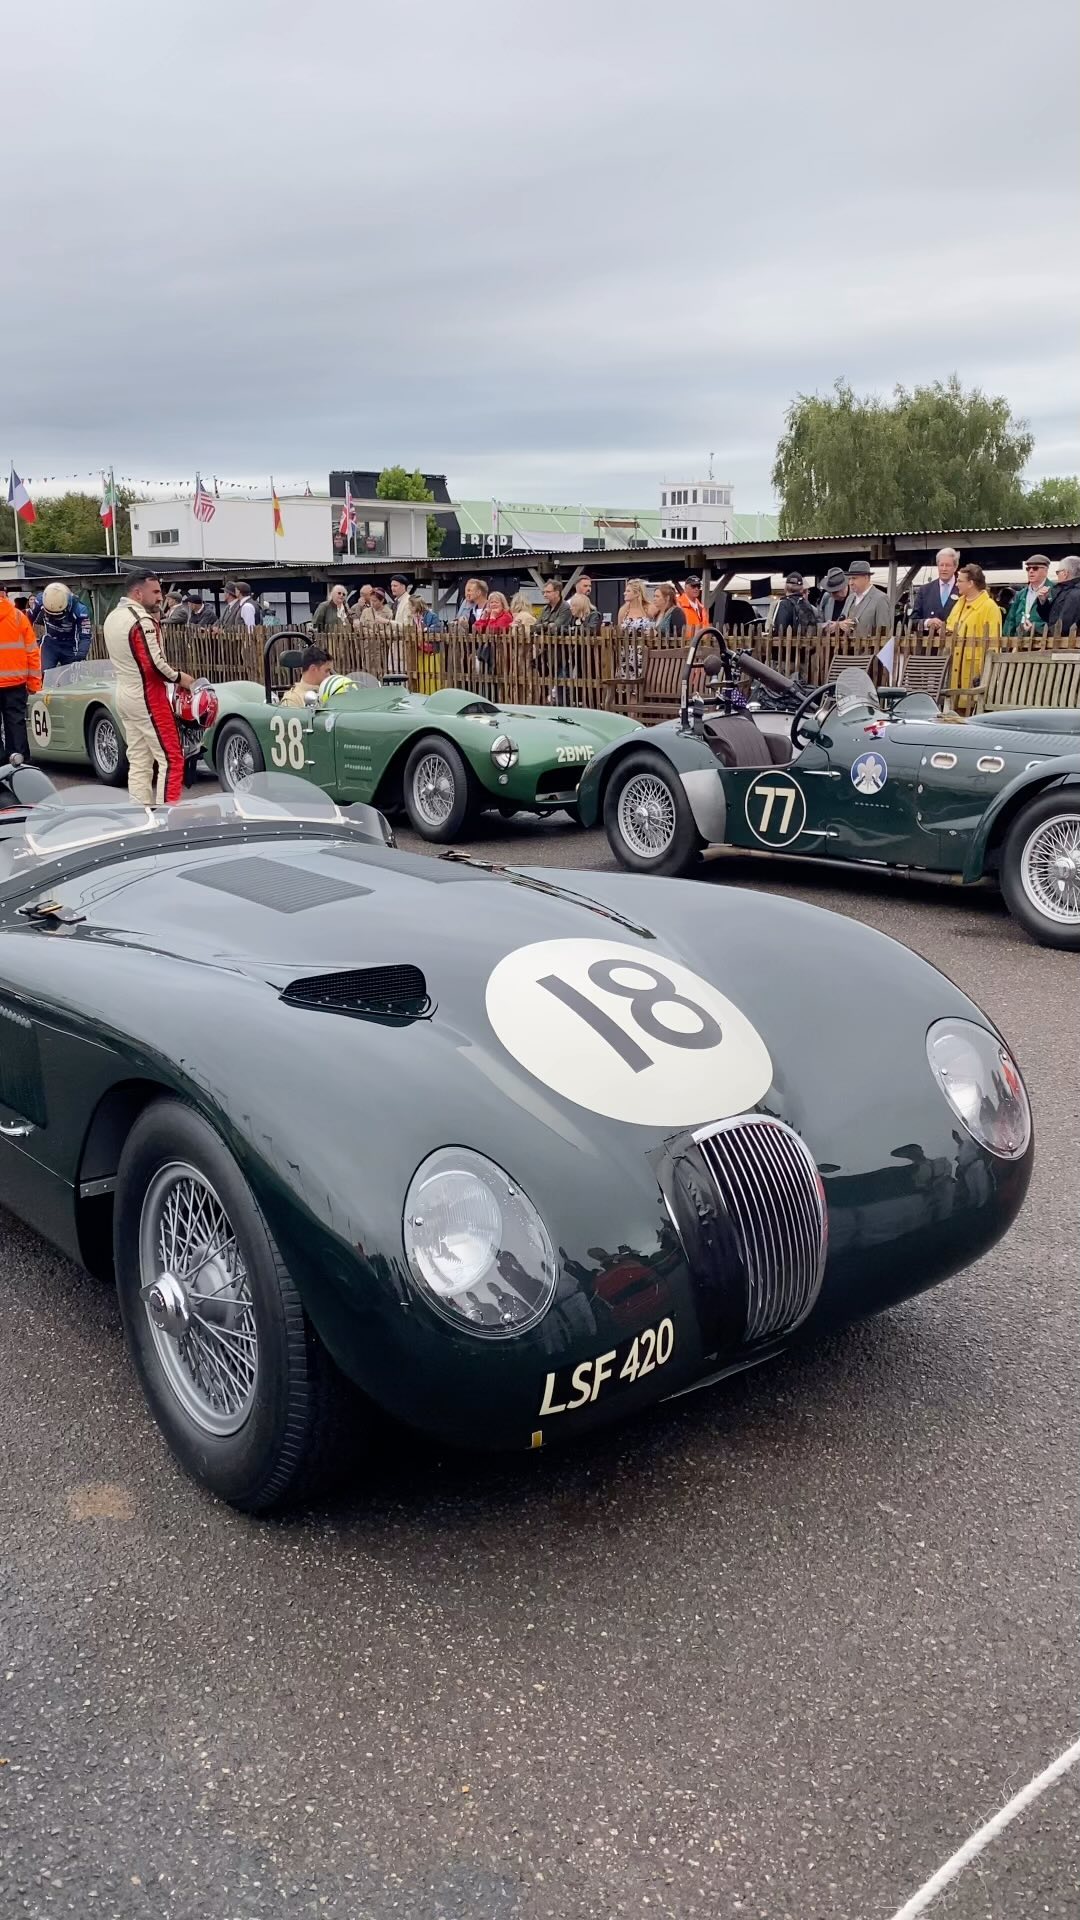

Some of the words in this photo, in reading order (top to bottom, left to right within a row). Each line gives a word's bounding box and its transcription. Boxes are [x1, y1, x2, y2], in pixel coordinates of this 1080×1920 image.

[34, 710, 48, 737] 64
[269, 715, 305, 770] 38
[755, 786, 796, 834] 77
[535, 959, 723, 1074] 18
[539, 1350, 616, 1415] LSF
[619, 1317, 674, 1383] 420
